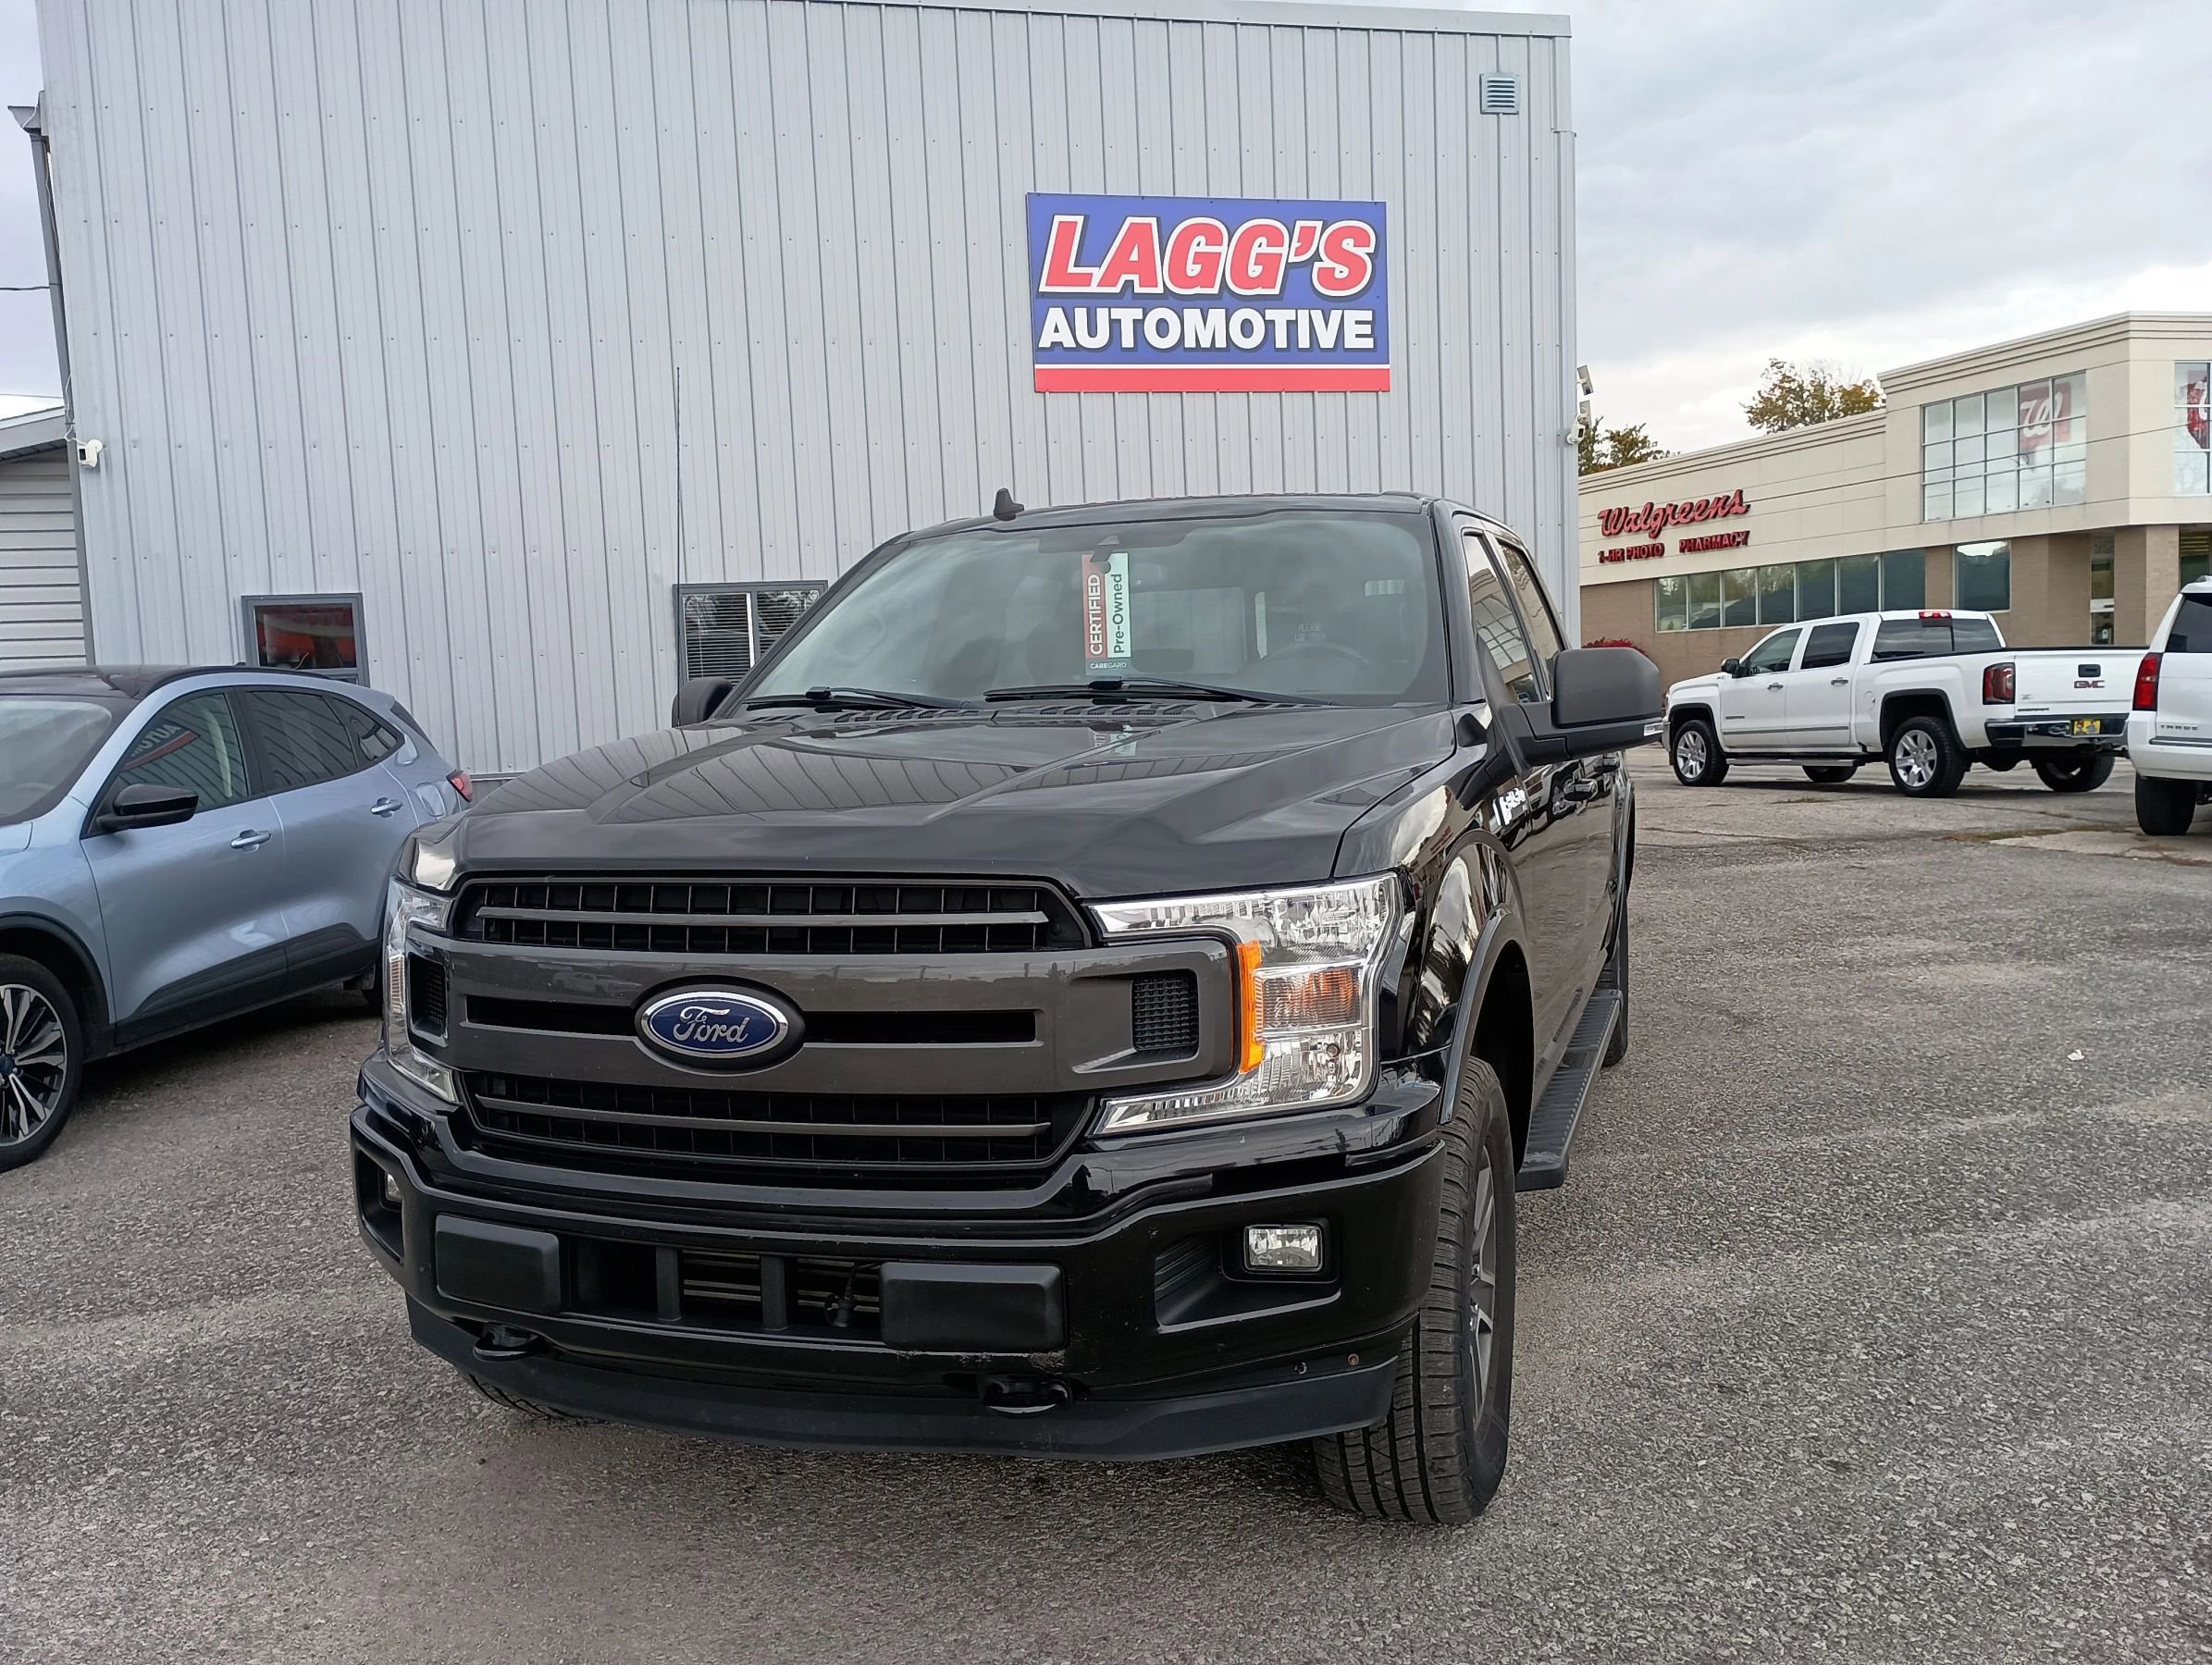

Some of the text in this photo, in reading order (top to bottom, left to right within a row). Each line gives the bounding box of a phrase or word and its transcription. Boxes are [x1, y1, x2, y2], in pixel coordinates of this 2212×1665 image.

[1038, 215, 1377, 296] LAGG'S
[1038, 306, 1375, 349] AUTOMOTIVE
[1598, 489, 1751, 538] Walgreens
[1625, 543, 1665, 561] PHOTO
[1679, 530, 1750, 553] PHARMACY
[1087, 574, 1103, 655] CERTIFIED
[1110, 574, 1125, 654] Pre-Owned
[2073, 680, 2106, 689] GMC
[673, 1005, 750, 1043] Ford
